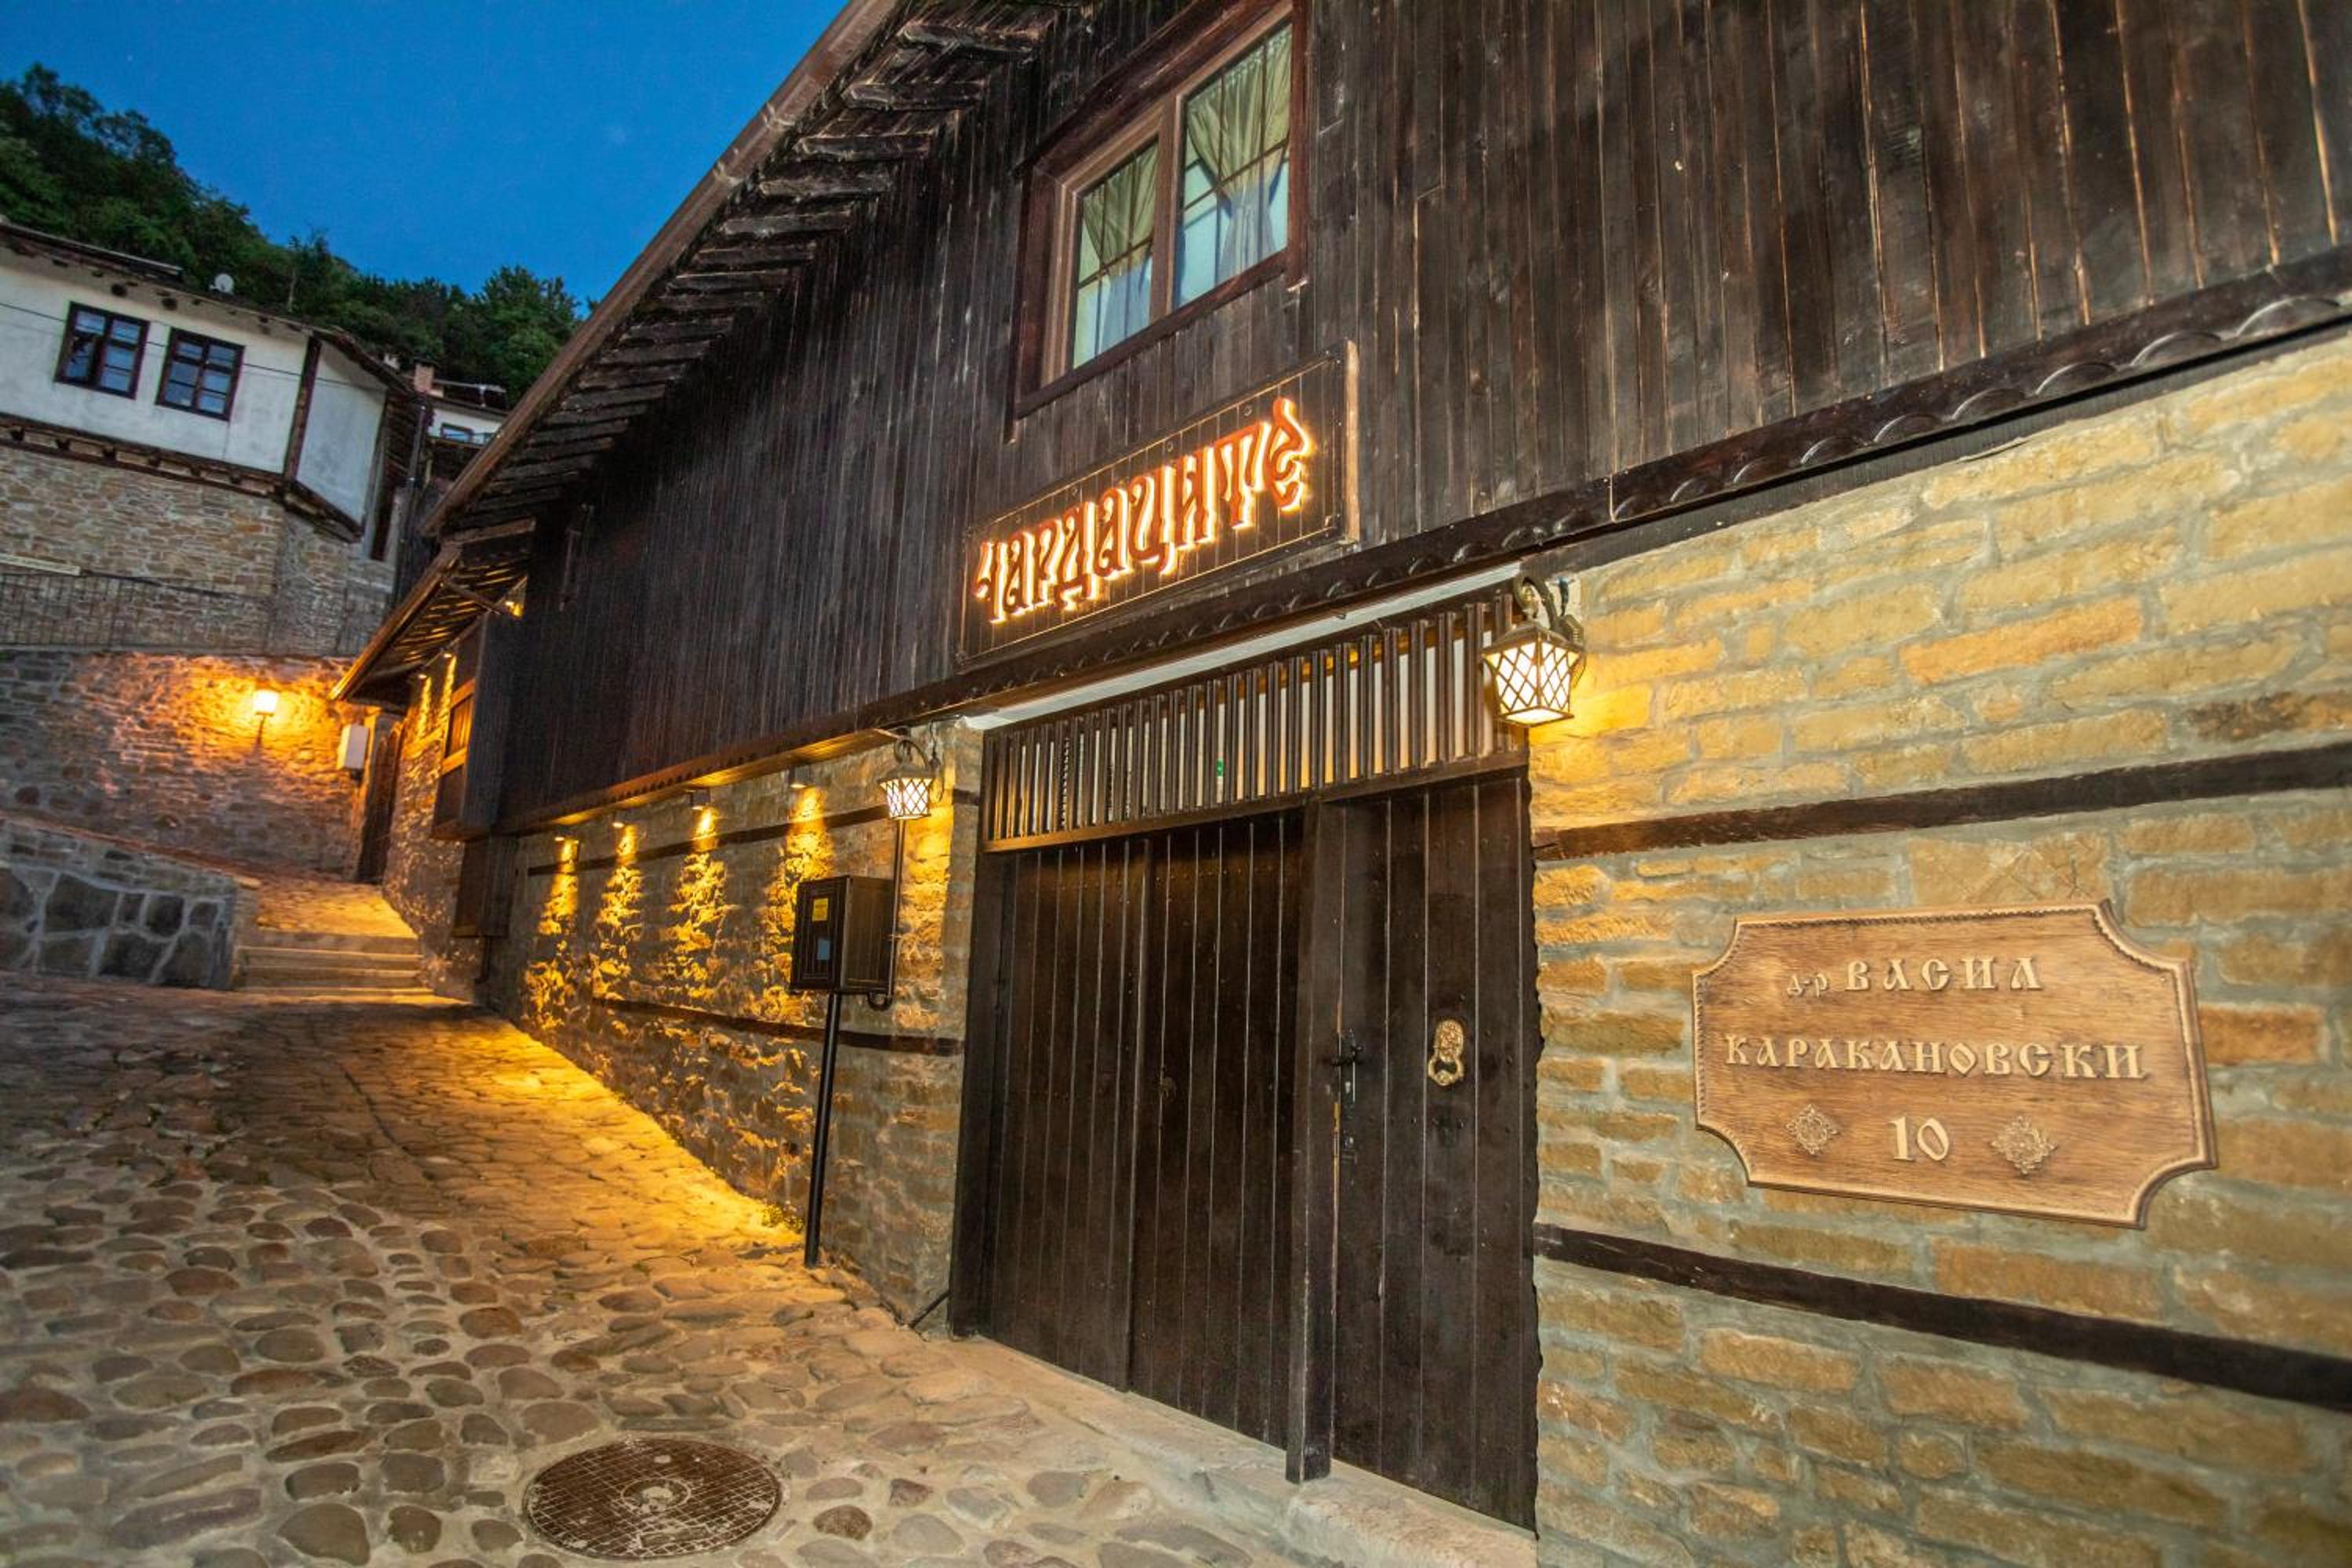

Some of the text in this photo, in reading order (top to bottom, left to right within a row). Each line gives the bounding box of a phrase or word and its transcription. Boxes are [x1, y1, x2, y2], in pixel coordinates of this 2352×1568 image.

[1787, 956, 2042, 996] д-р ВАСИЛ
[1726, 1033, 2147, 1080] КАРАКАНОВСКИ
[1890, 1116, 1950, 1162] 10
